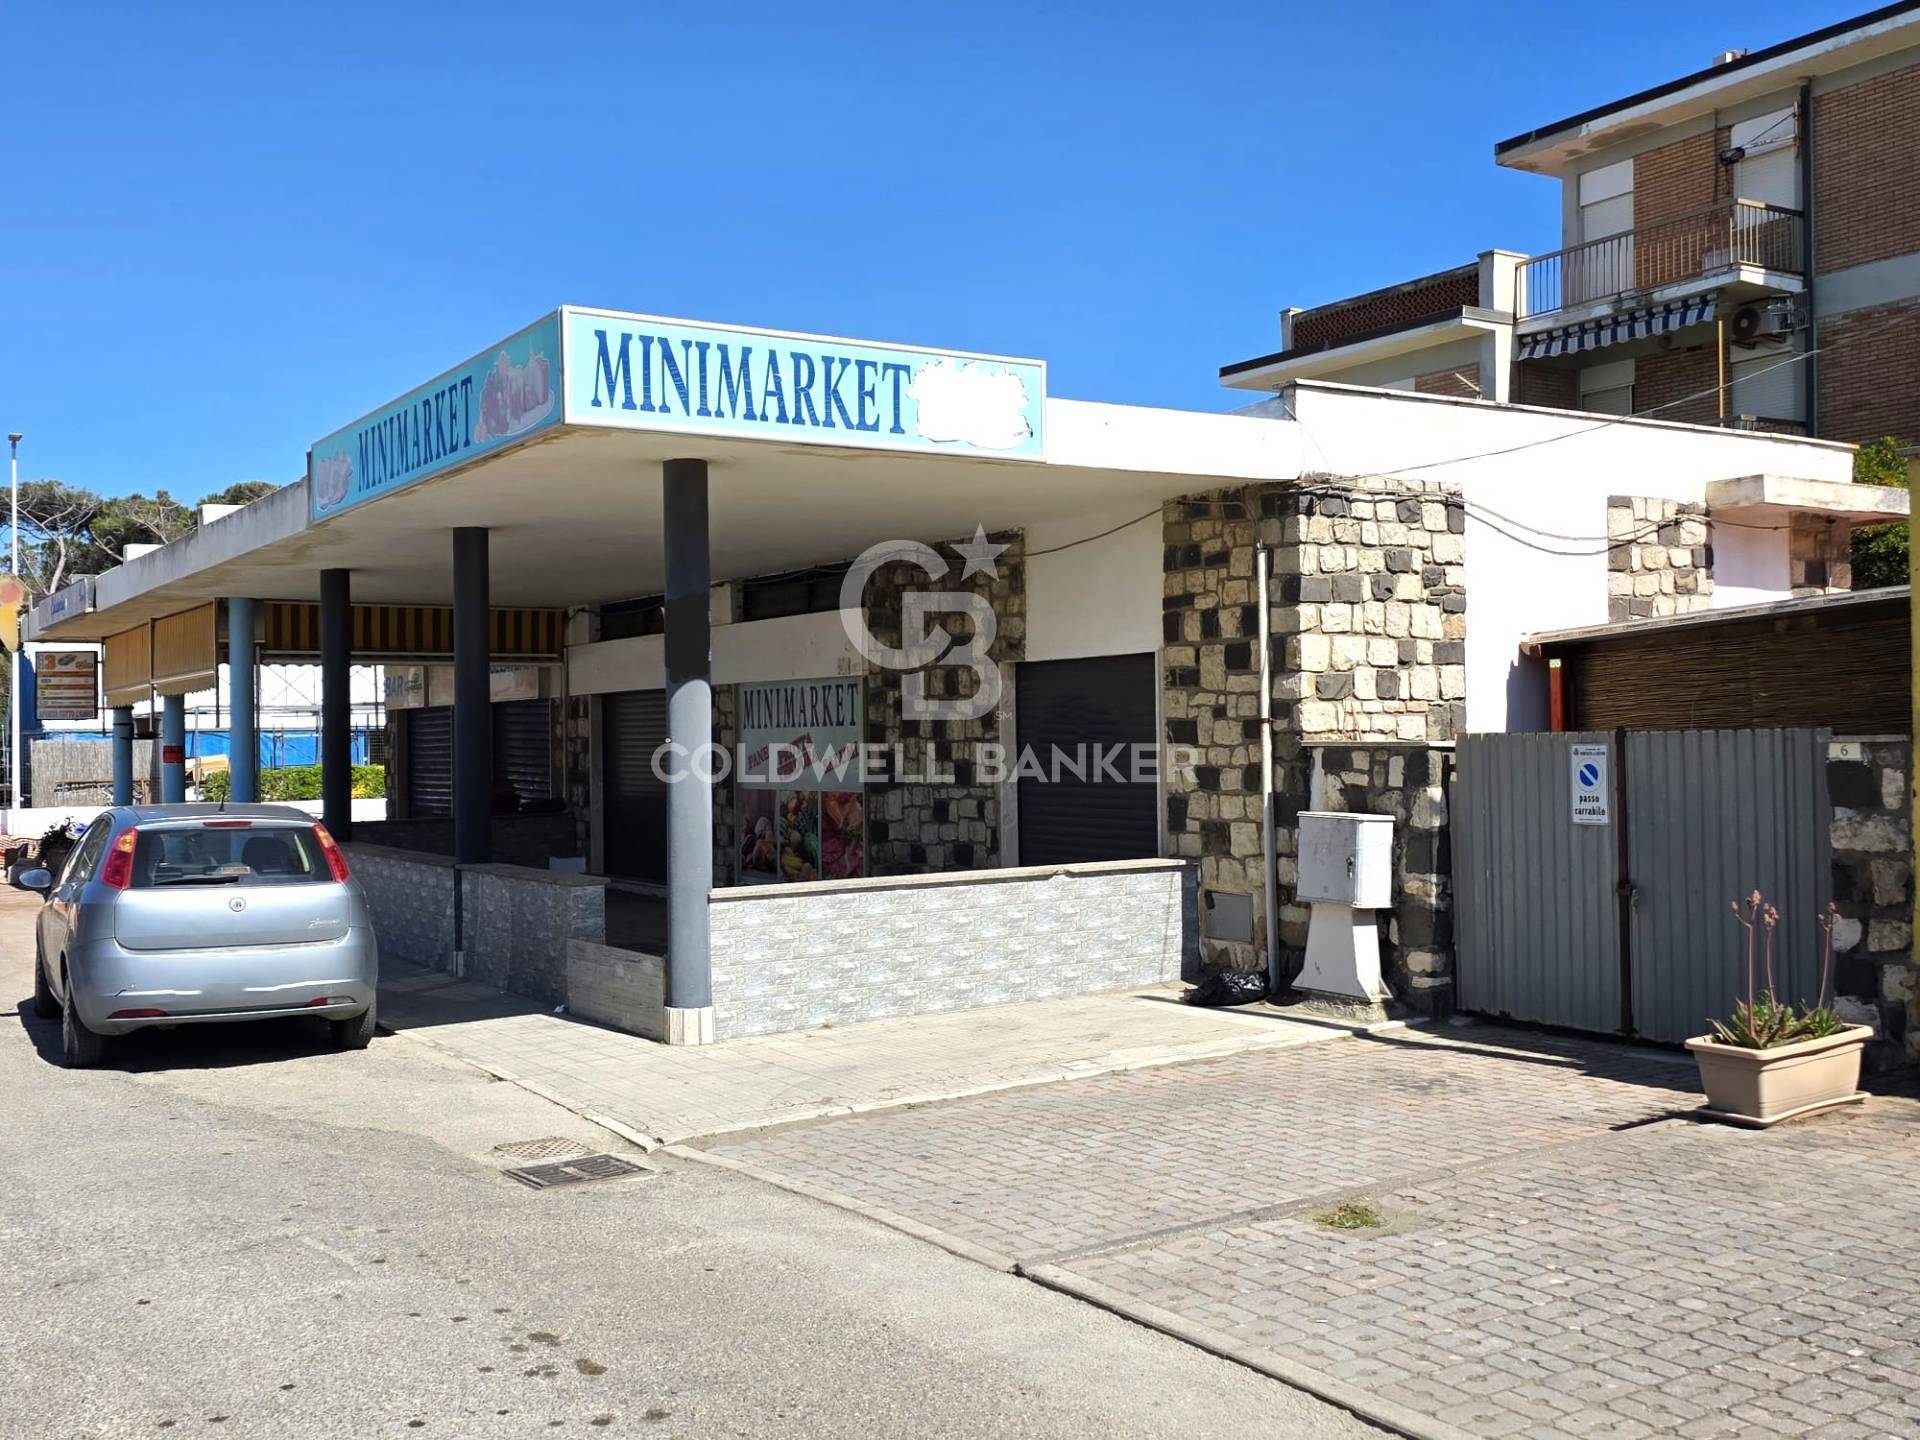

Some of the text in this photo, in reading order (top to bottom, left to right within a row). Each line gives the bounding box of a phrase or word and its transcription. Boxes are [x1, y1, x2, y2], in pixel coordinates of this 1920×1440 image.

[590, 329, 911, 435] MINIMARKET
[358, 375, 473, 493] MINIMARKET
[384, 675, 403, 697] BAR
[743, 683, 858, 730] MINIMARKET
[1840, 744, 1849, 757] 6
[1574, 806, 1606, 816] carrabile
[1579, 795, 1600, 805] passo
